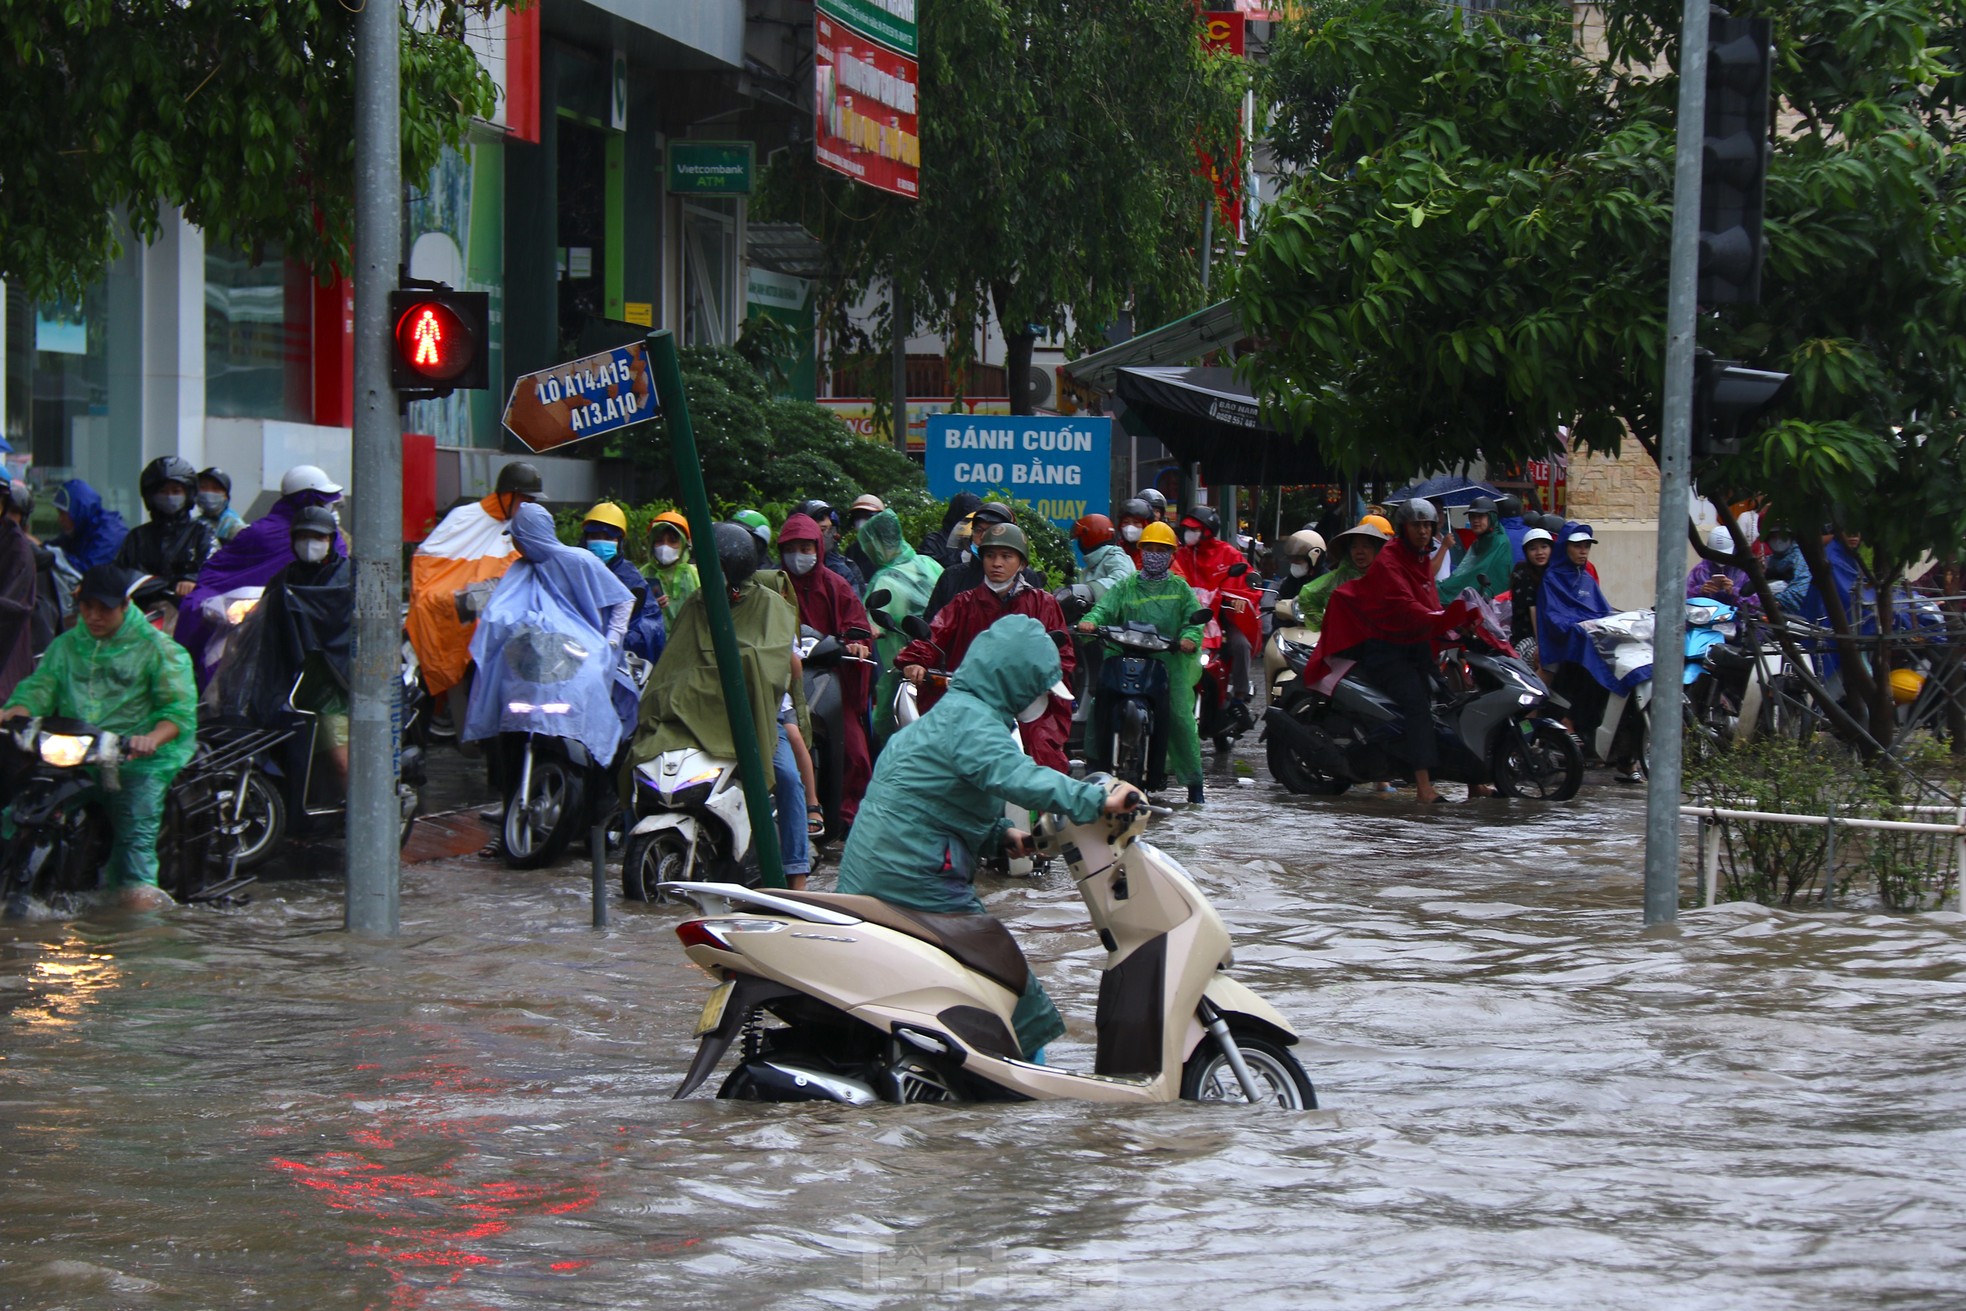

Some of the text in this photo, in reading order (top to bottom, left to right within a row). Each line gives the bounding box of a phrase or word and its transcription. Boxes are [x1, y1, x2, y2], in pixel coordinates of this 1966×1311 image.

[677, 163, 744, 175] Vietcombank
[696, 176, 726, 187] ATM
[537, 358, 631, 406] LÔ A14.A15
[571, 392, 638, 431] A13.A10
[945, 424, 1093, 451] BÁNH CUỐN
[954, 456, 1082, 485] CAO BẰNG
[1037, 499, 1088, 520] QUAY
